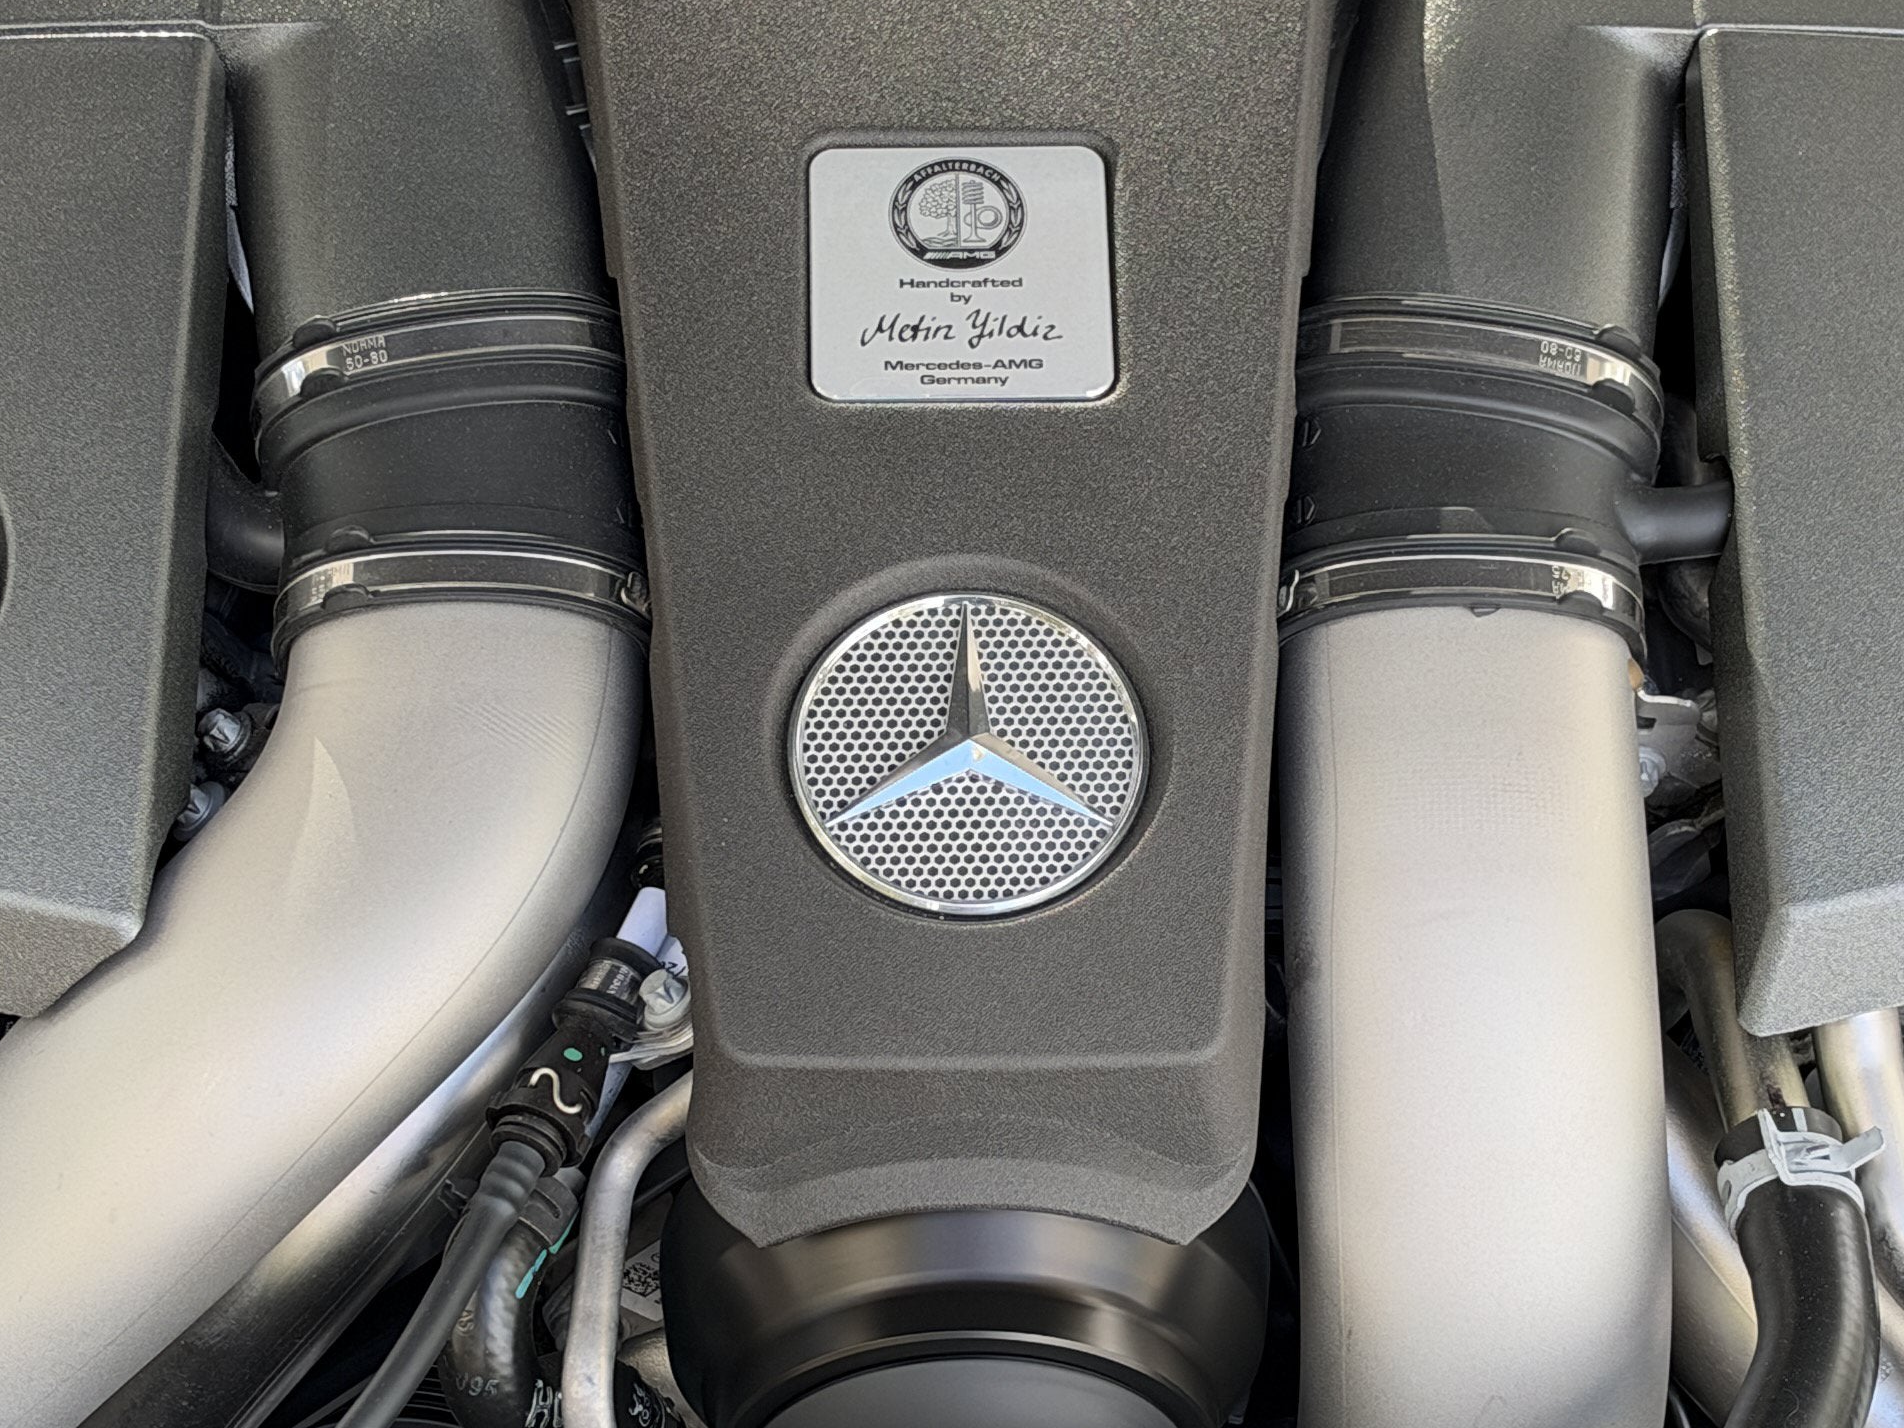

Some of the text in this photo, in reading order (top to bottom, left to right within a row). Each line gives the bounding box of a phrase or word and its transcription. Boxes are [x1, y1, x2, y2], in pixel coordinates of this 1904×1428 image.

[911, 160, 1003, 185] AFFALTERBACH
[944, 250, 997, 261] AMG
[898, 276, 1024, 290] Handcrafted
[949, 291, 973, 306] by
[883, 358, 1045, 372] Mercedes-AMG
[919, 374, 1010, 388] Germany
